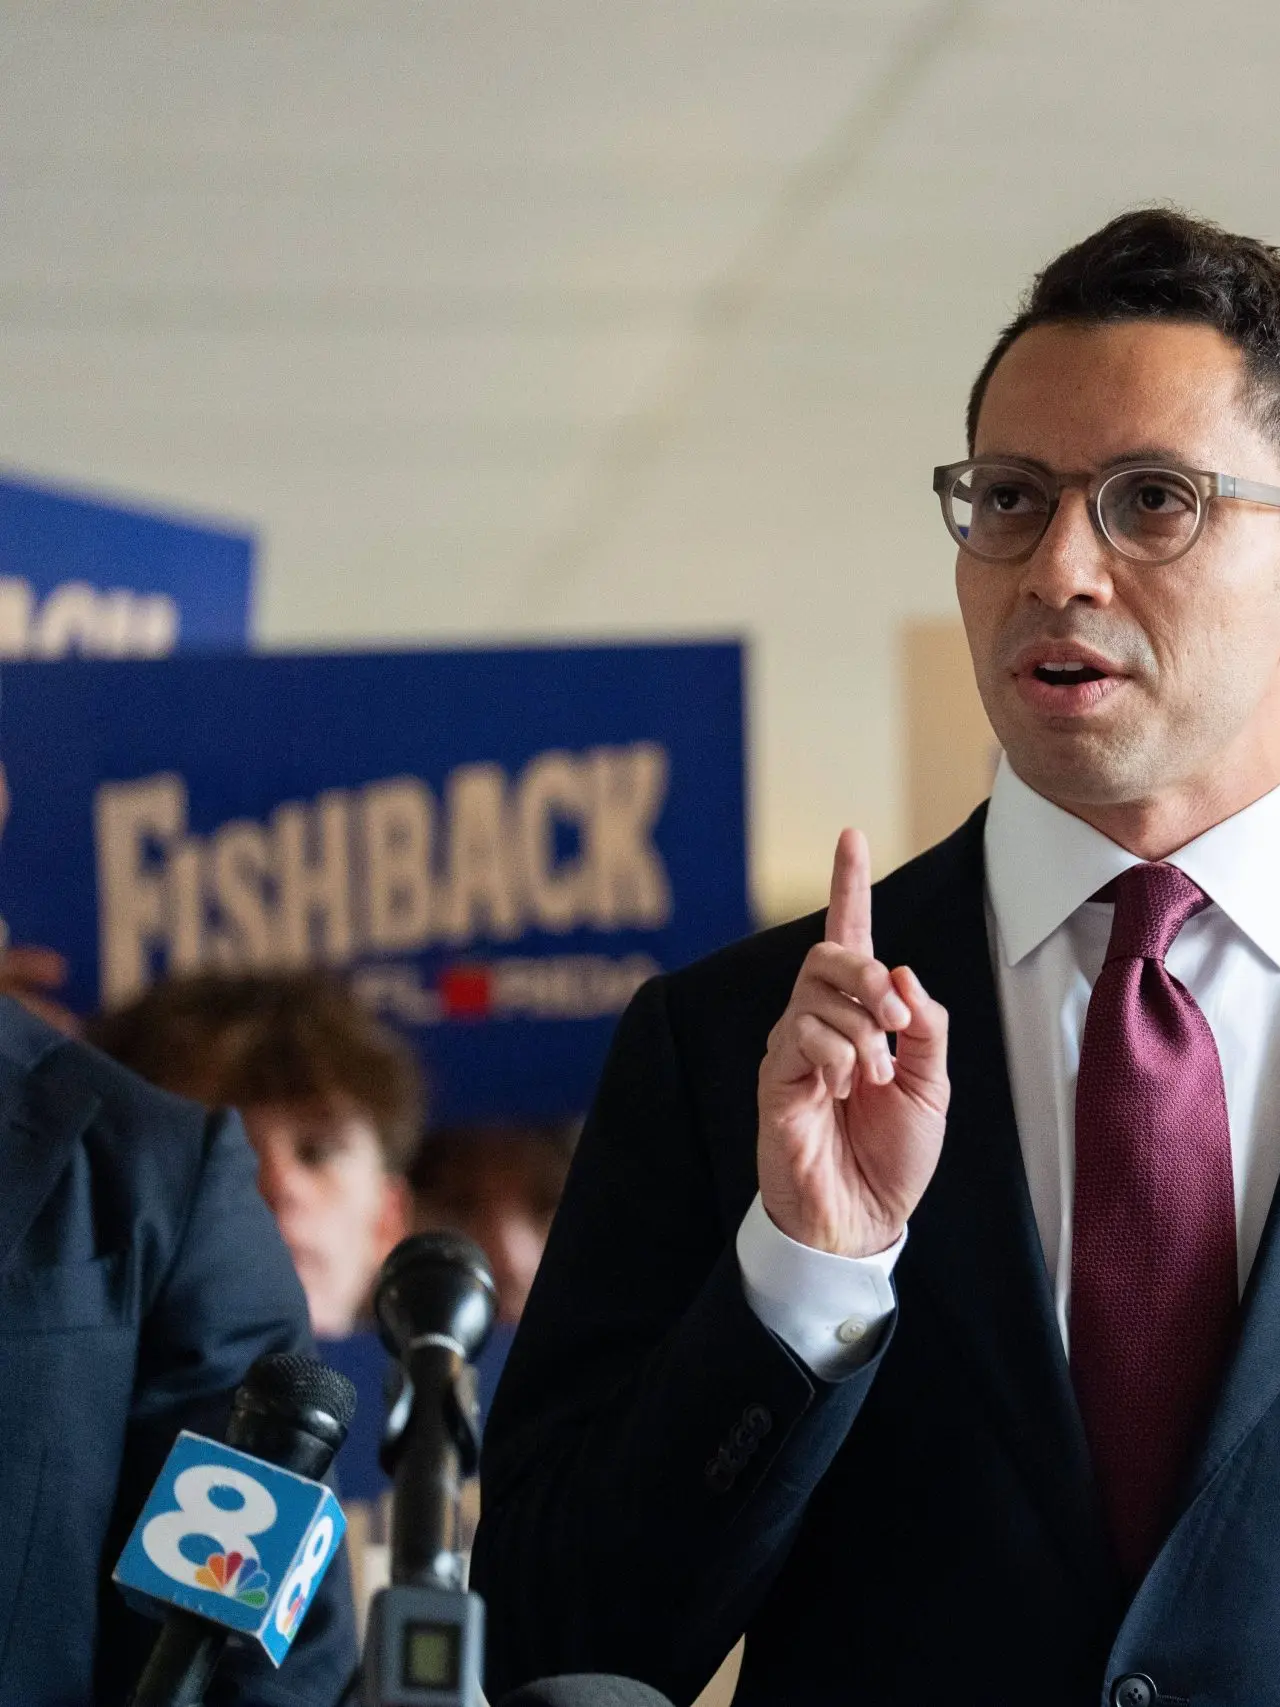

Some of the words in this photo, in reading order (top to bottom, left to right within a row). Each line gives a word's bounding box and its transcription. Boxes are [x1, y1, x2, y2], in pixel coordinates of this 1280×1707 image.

[96, 742, 672, 1008] FISHBACK
[142, 1464, 276, 1597] 8
[275, 1515, 333, 1642] 8
